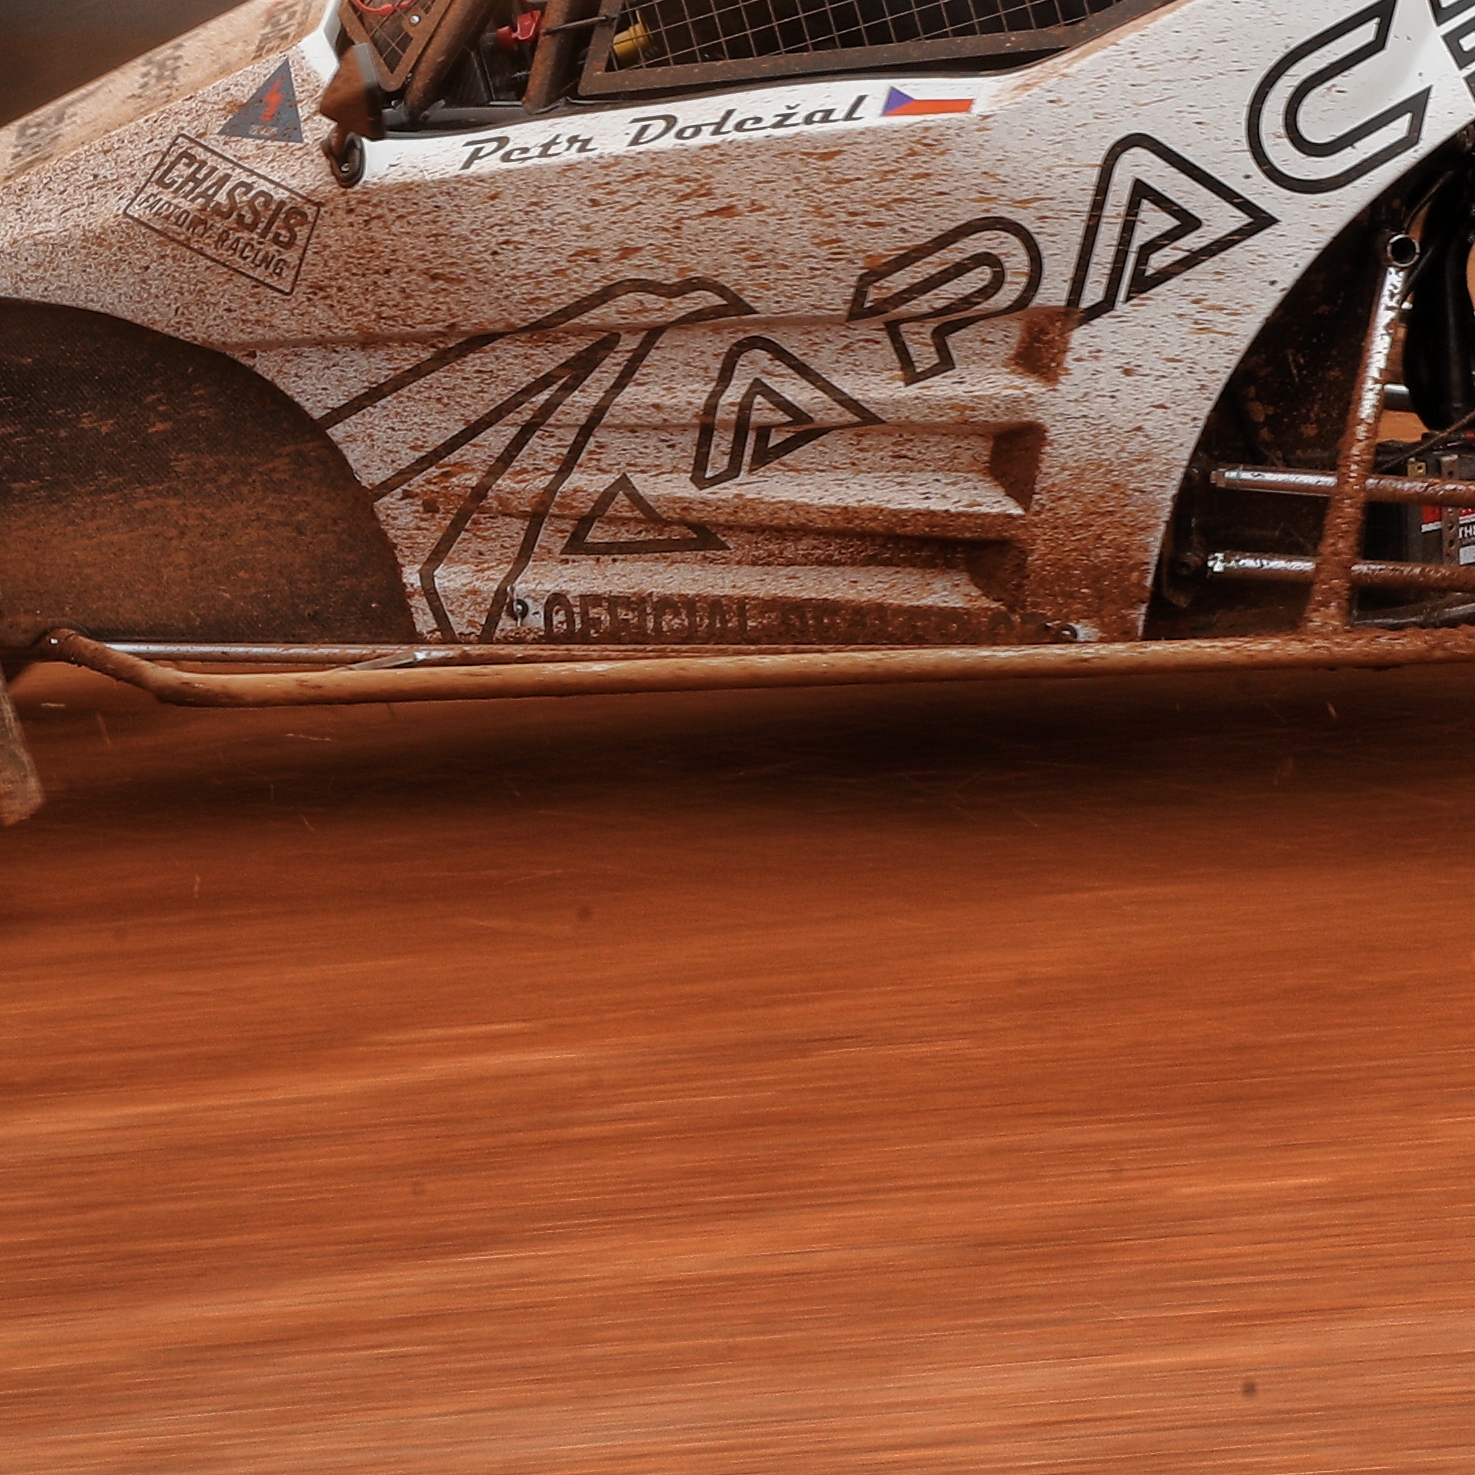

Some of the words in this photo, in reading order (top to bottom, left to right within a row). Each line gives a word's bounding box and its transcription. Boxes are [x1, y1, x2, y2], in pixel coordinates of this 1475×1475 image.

[458, 133, 599, 172] Petr
[625, 94, 869, 149] Doležal
[137, 191, 215, 238] FACTORY
[215, 230, 289, 277] RACING
[154, 150, 309, 251] CHASSIS
